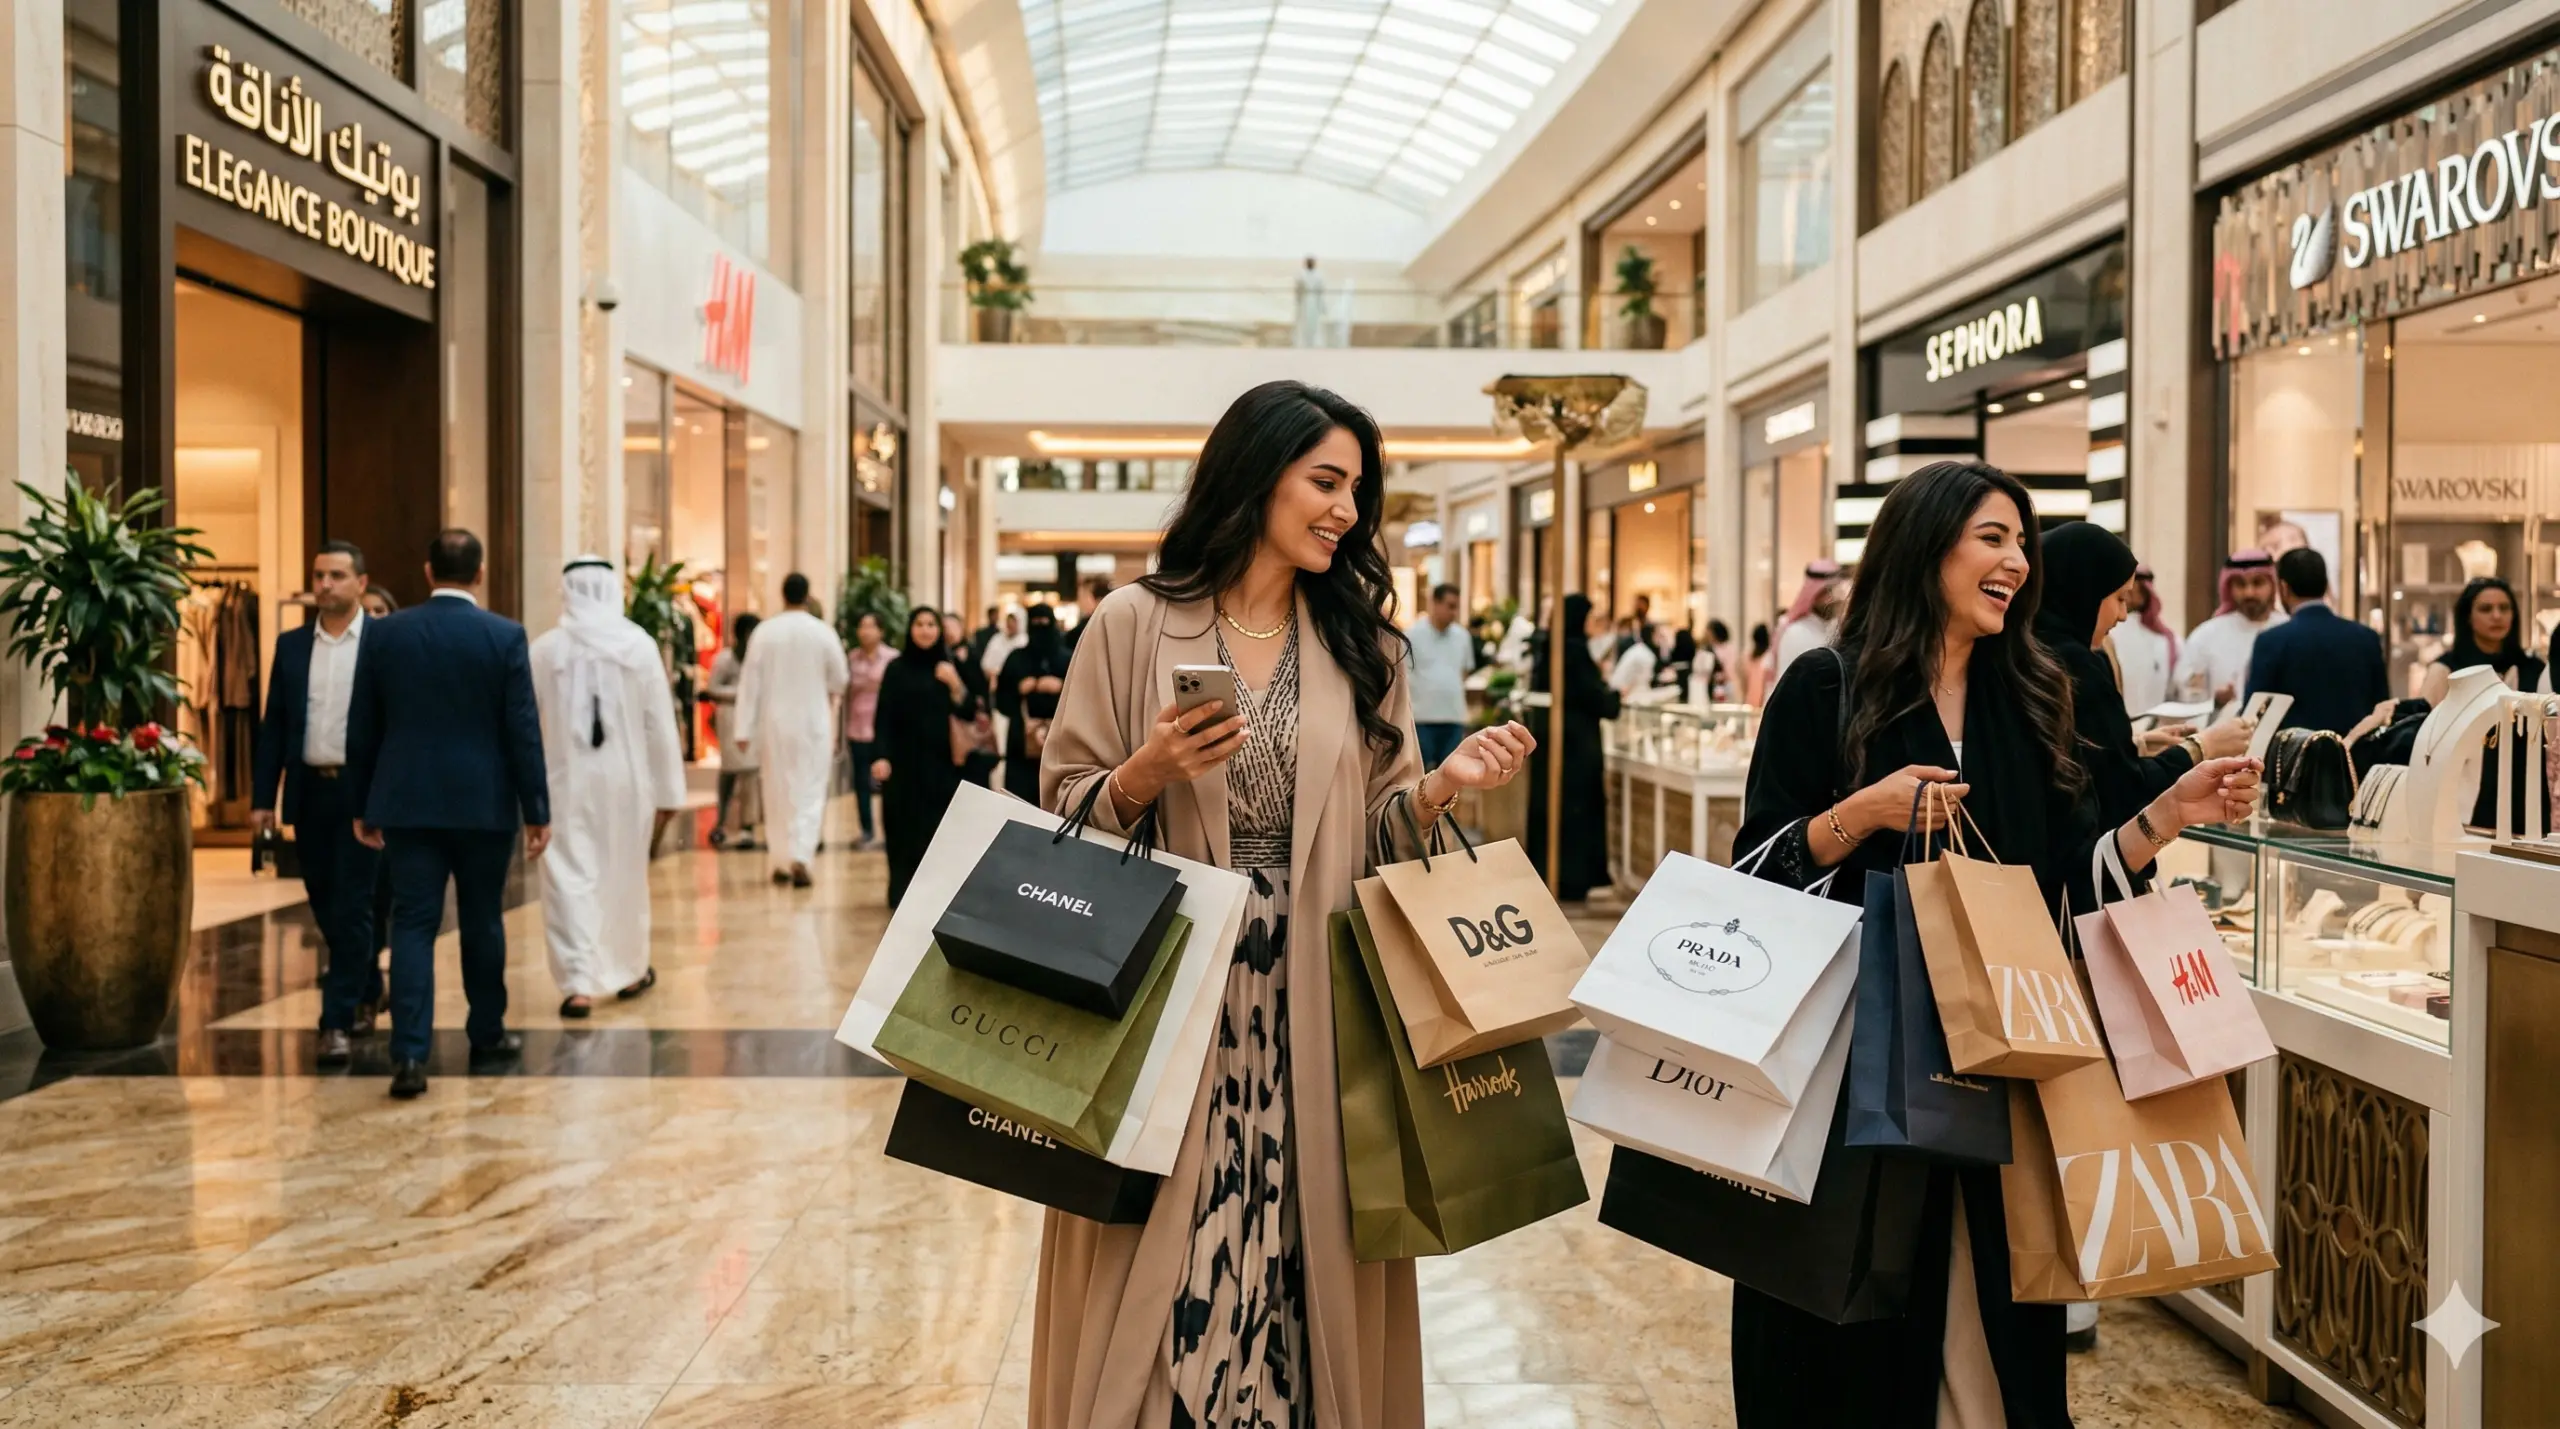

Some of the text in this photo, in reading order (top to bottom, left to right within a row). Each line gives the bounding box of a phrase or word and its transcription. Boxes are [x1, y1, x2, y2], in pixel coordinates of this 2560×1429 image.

[209, 44, 421, 226] بوتيك الأناقة
[186, 133, 435, 289] ELEGANCE BOUTIQUE
[1925, 296, 2043, 383] SEPHORA
[2391, 477, 2526, 501] WAROVSKI
[1017, 882, 1094, 917] CHANEL
[1446, 903, 1534, 958] D&G
[1676, 938, 1742, 969] PRADA
[1985, 964, 2101, 1048] ZARA
[2168, 948, 2221, 1006] H&M
[950, 1004, 1059, 1063] GUCCI
[1442, 1054, 1522, 1114] Harrods
[1645, 1058, 1734, 1102] Dior
[2055, 1132, 2274, 1286] ZARA
